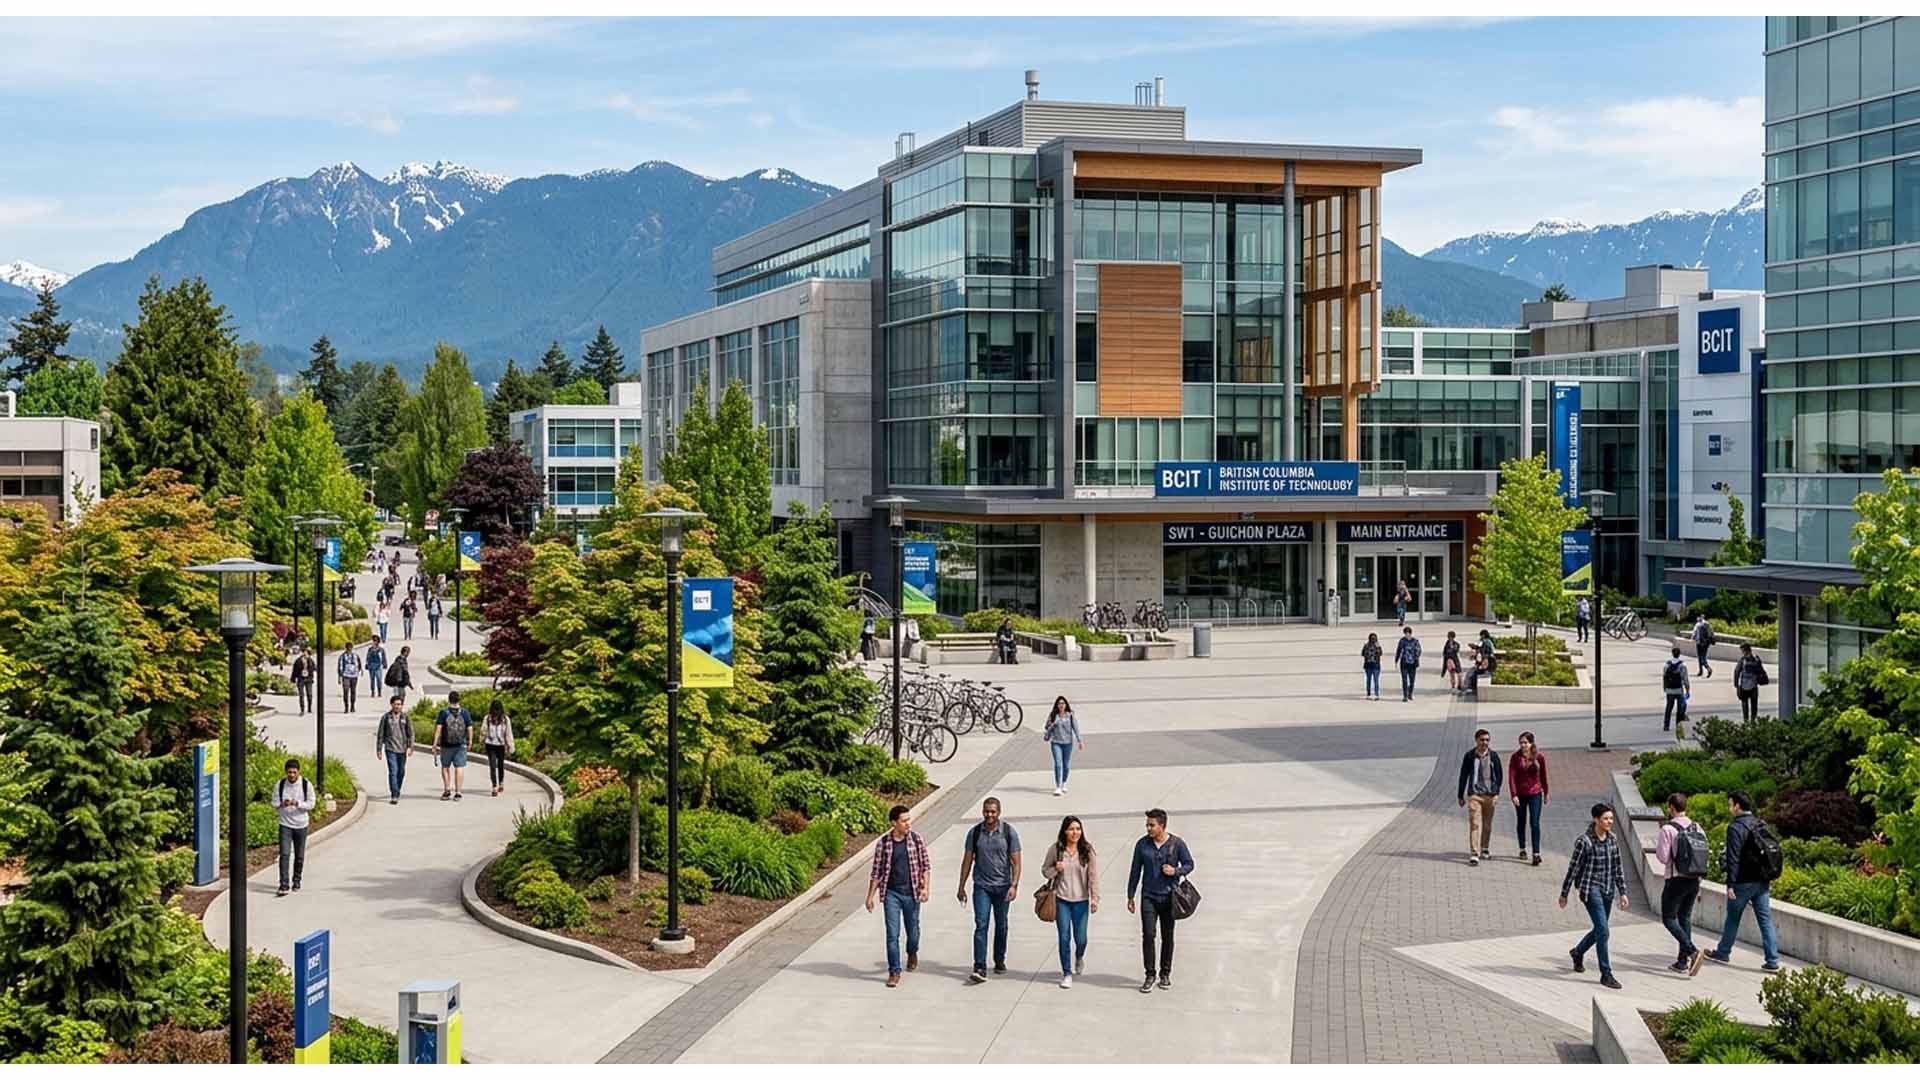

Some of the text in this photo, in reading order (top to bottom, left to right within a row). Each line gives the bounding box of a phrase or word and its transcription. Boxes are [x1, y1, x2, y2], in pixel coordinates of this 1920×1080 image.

[1701, 327, 1734, 354] BCIT
[1162, 469, 1202, 488] BCIT
[1262, 466, 1315, 478] COLUMBIA
[1220, 479, 1270, 491] INSTITUTE
[1273, 479, 1287, 491] OF
[1168, 525, 1195, 539] SW1
[1208, 525, 1263, 540] GUICHON
[1266, 525, 1306, 539] PLAZA
[1350, 524, 1448, 538] MAIN ENTRANCE
